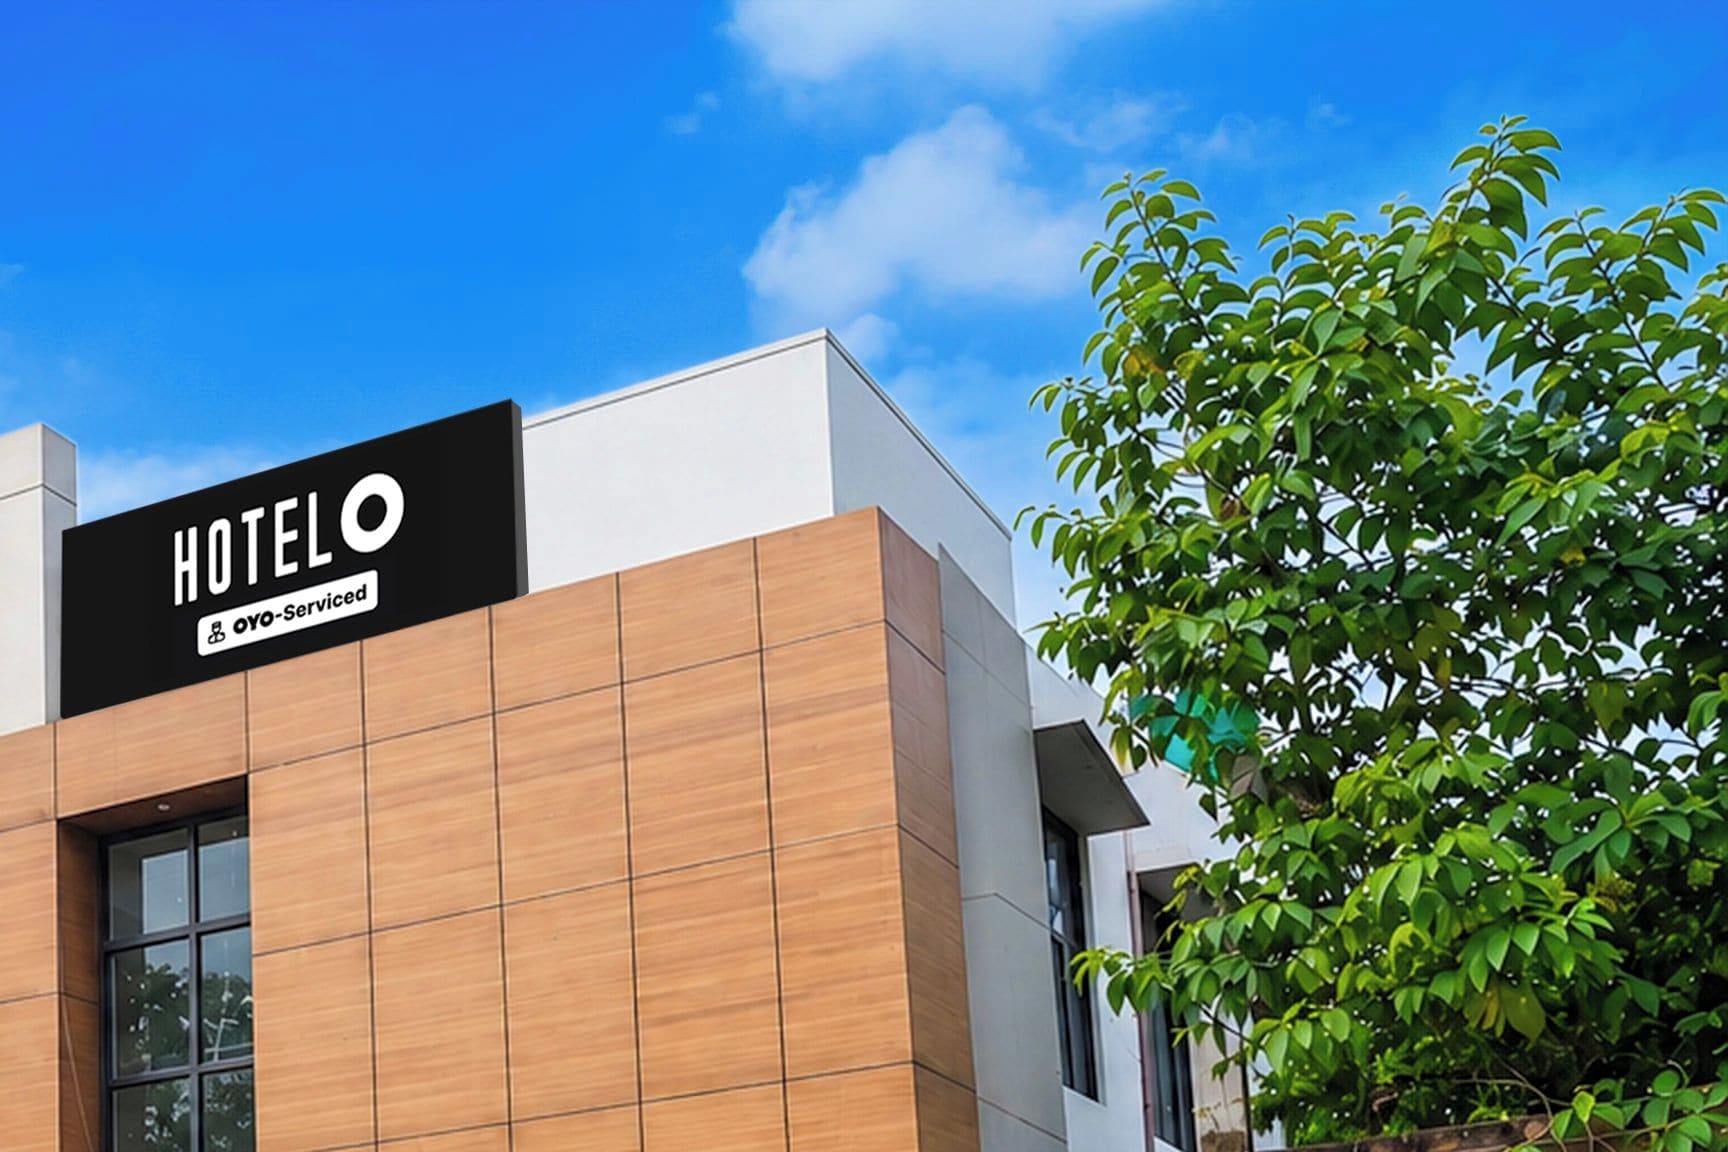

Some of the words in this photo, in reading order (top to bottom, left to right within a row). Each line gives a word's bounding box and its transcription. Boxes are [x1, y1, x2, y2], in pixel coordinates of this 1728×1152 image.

[174, 491, 333, 606] HOTEL
[340, 473, 405, 553] O
[232, 584, 367, 635] OYO-Serviced
